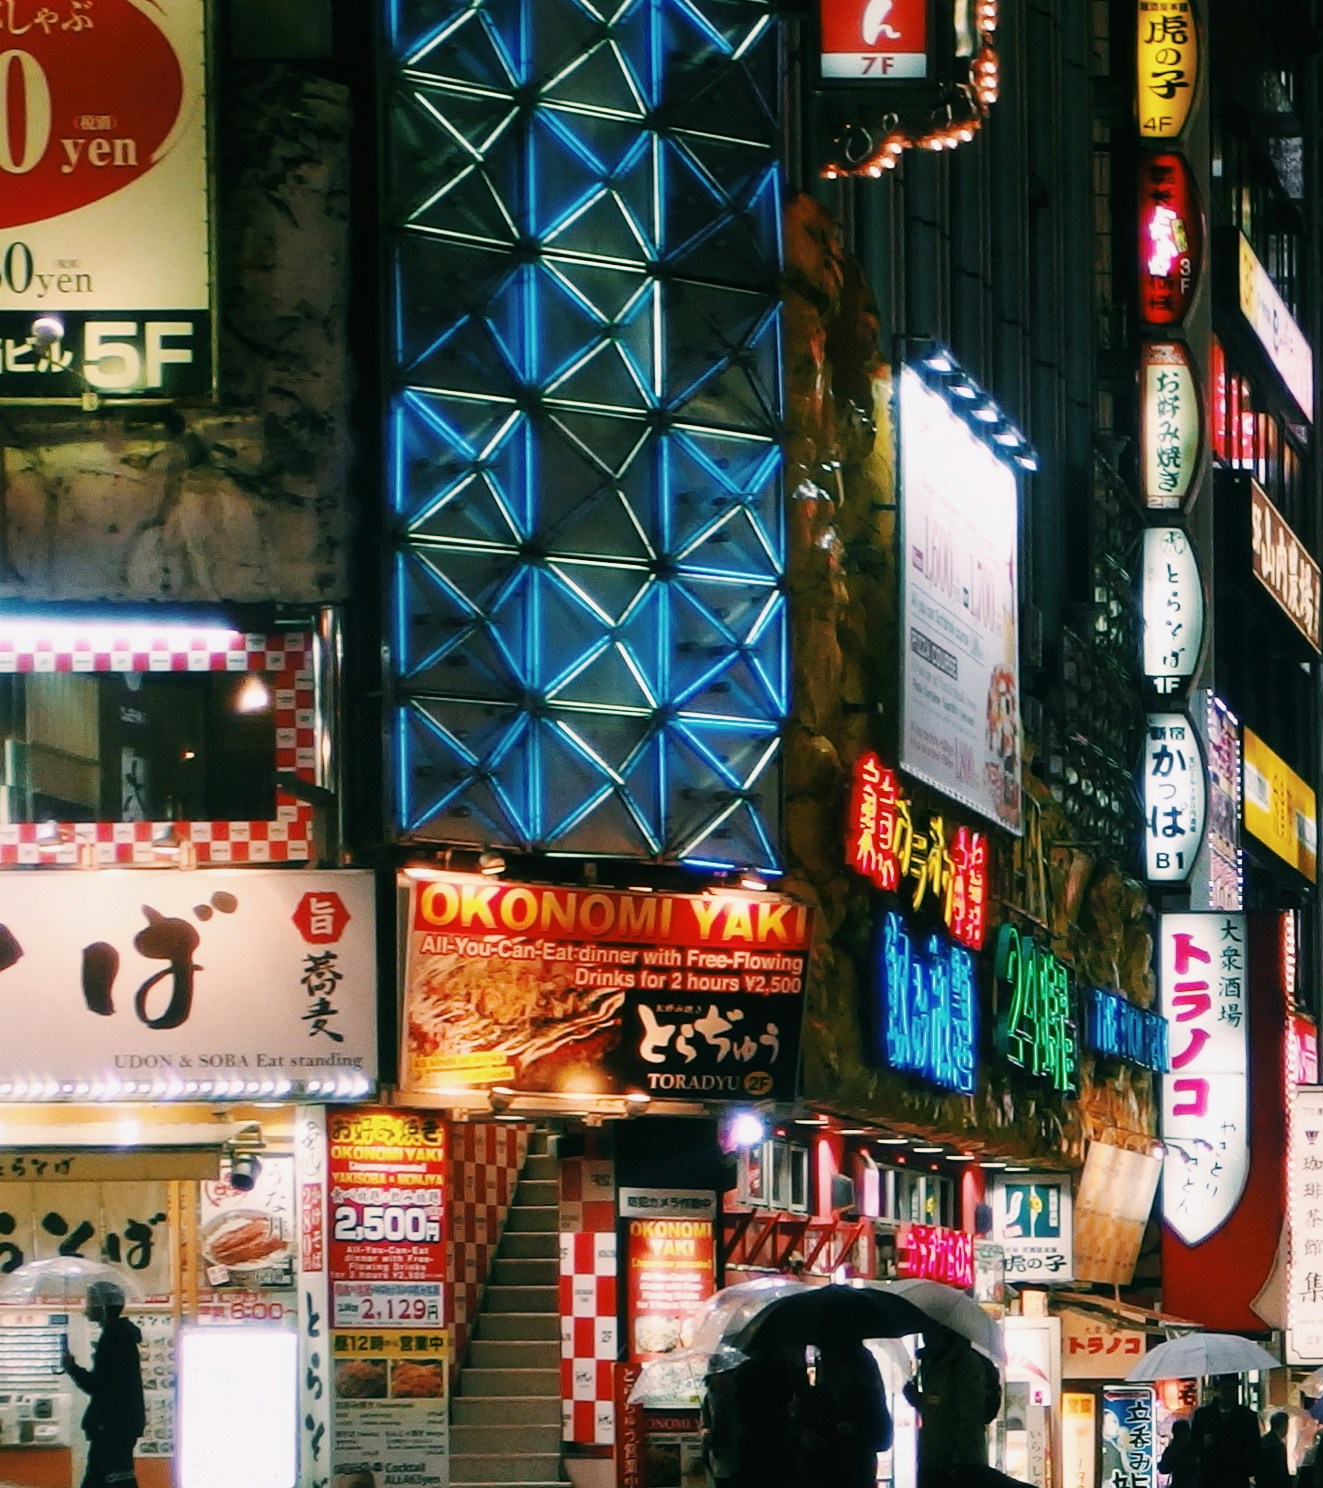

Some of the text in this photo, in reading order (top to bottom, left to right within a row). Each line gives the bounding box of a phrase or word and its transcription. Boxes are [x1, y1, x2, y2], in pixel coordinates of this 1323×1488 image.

[861, 57, 893, 75] 7F
[1144, 15, 1189, 99] 虎の子
[1143, 116, 1172, 131] 4F
[60, 138, 138, 173] yen
[35, 273, 94, 298] yen
[83, 322, 193, 389] 5F
[1157, 371, 1182, 492] お好み焼き
[1161, 563, 1185, 669] とらそば
[1154, 678, 1180, 693] 1F
[1151, 744, 1188, 838] かっぱ
[1156, 852, 1184, 870] B1
[420, 881, 807, 945] OKONOMI YAKI
[420, 934, 803, 974] All-You-Can-Eat dinner with Free-Flowing
[574, 968, 801, 994] Drinks for 2 hours ¥2,500
[1218, 919, 1244, 1029] 大衆酒場
[301, 952, 343, 1042] 蕎麦
[1171, 932, 1211, 1117] トラノコ
[114, 1052, 364, 1071] UDON & SOBA Eat standing
[648, 1072, 770, 1093] TORADYU 2F
[331, 1147, 445, 1161] OKONOMIYAKI
[334, 1206, 441, 1242] 2,500円
[630, 1221, 713, 1238] OKONOMI
[649, 1239, 696, 1256] YAKI
[1003, 1254, 1067, 1273] 虎の子
[361, 1298, 439, 1321] 2,129円
[1069, 1336, 1141, 1355] トラノコ
